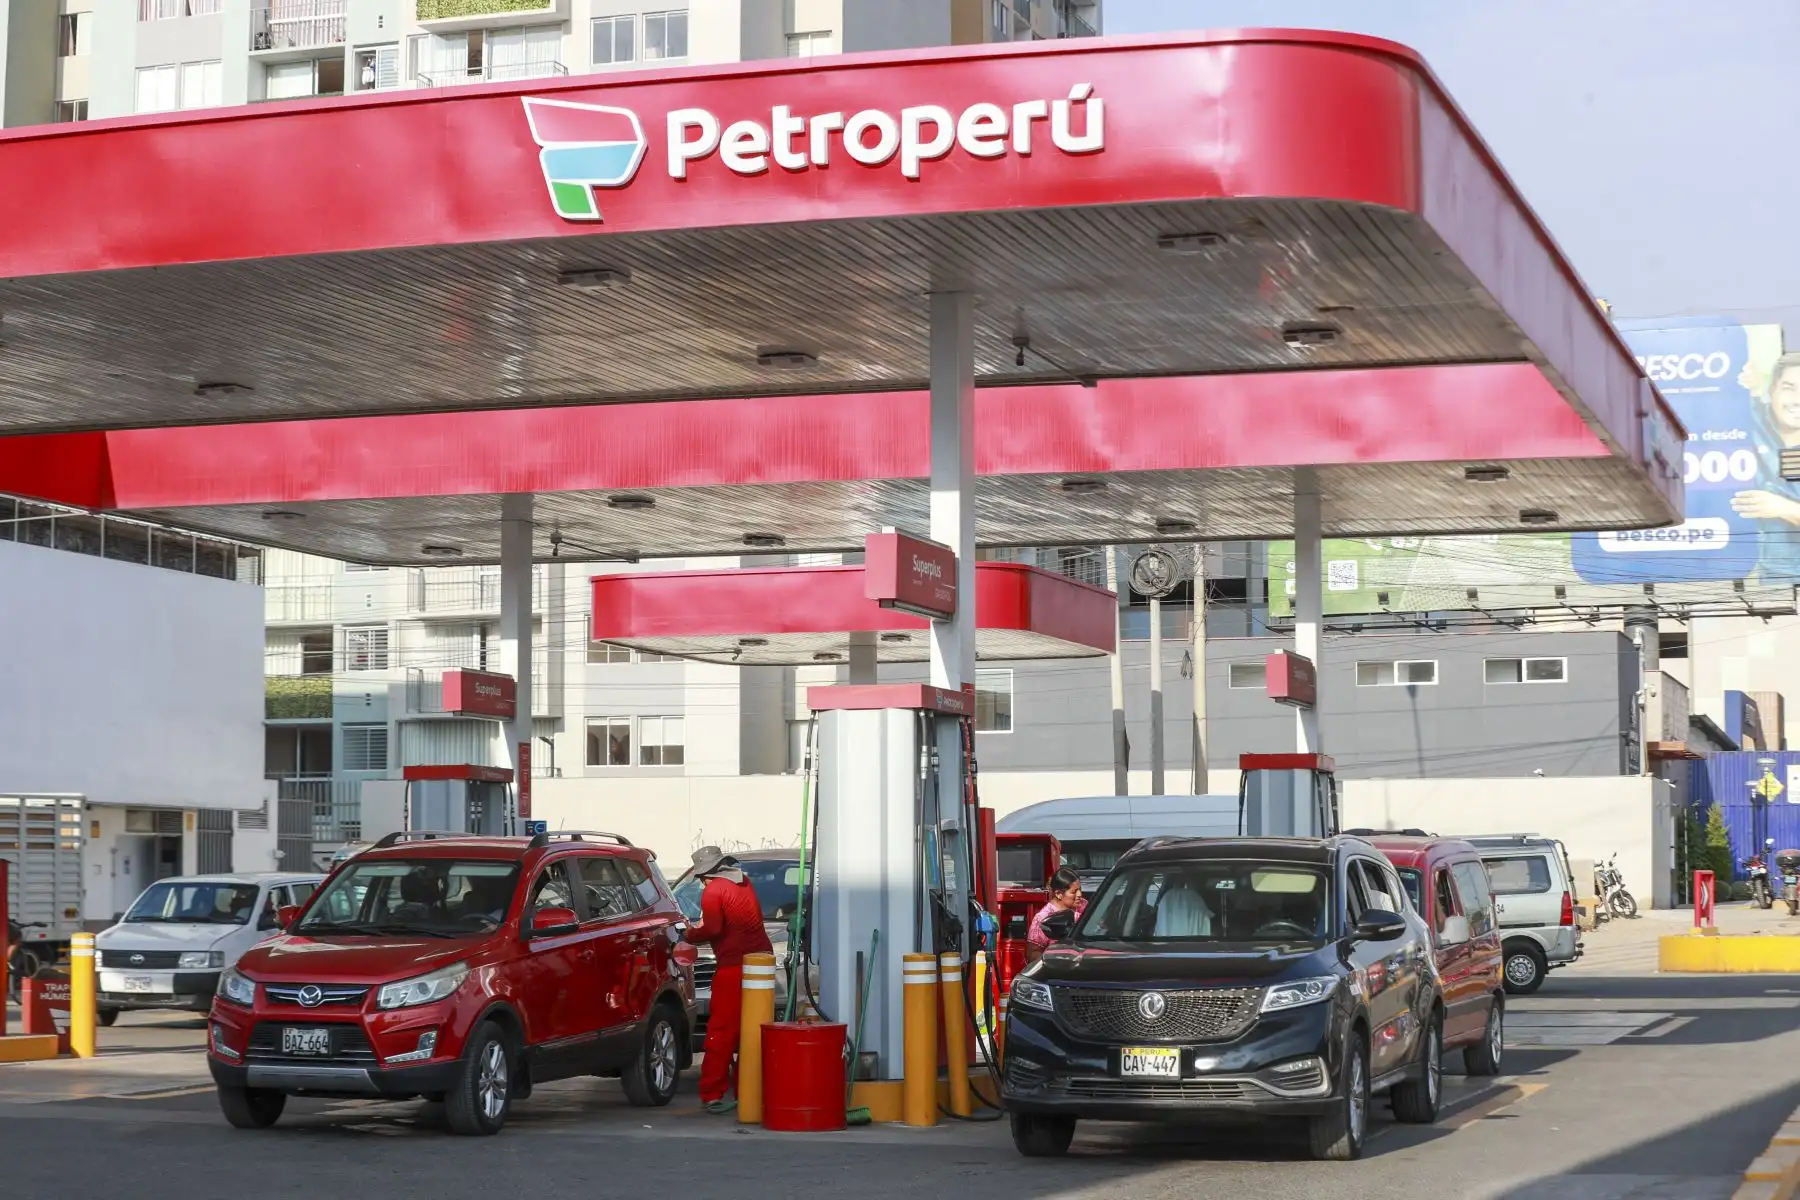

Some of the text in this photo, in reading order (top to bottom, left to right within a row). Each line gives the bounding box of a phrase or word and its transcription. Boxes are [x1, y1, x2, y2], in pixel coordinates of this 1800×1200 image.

[666, 82, 1106, 181] Petroperú
[1702, 428, 1747, 441] desde
[912, 554, 942, 581] Superplus
[475, 681, 502, 697] Superplus
[44, 983, 72, 992] TRAP
[284, 1034, 328, 1051] BAZ-664
[1123, 1054, 1177, 1073] CAY-447
